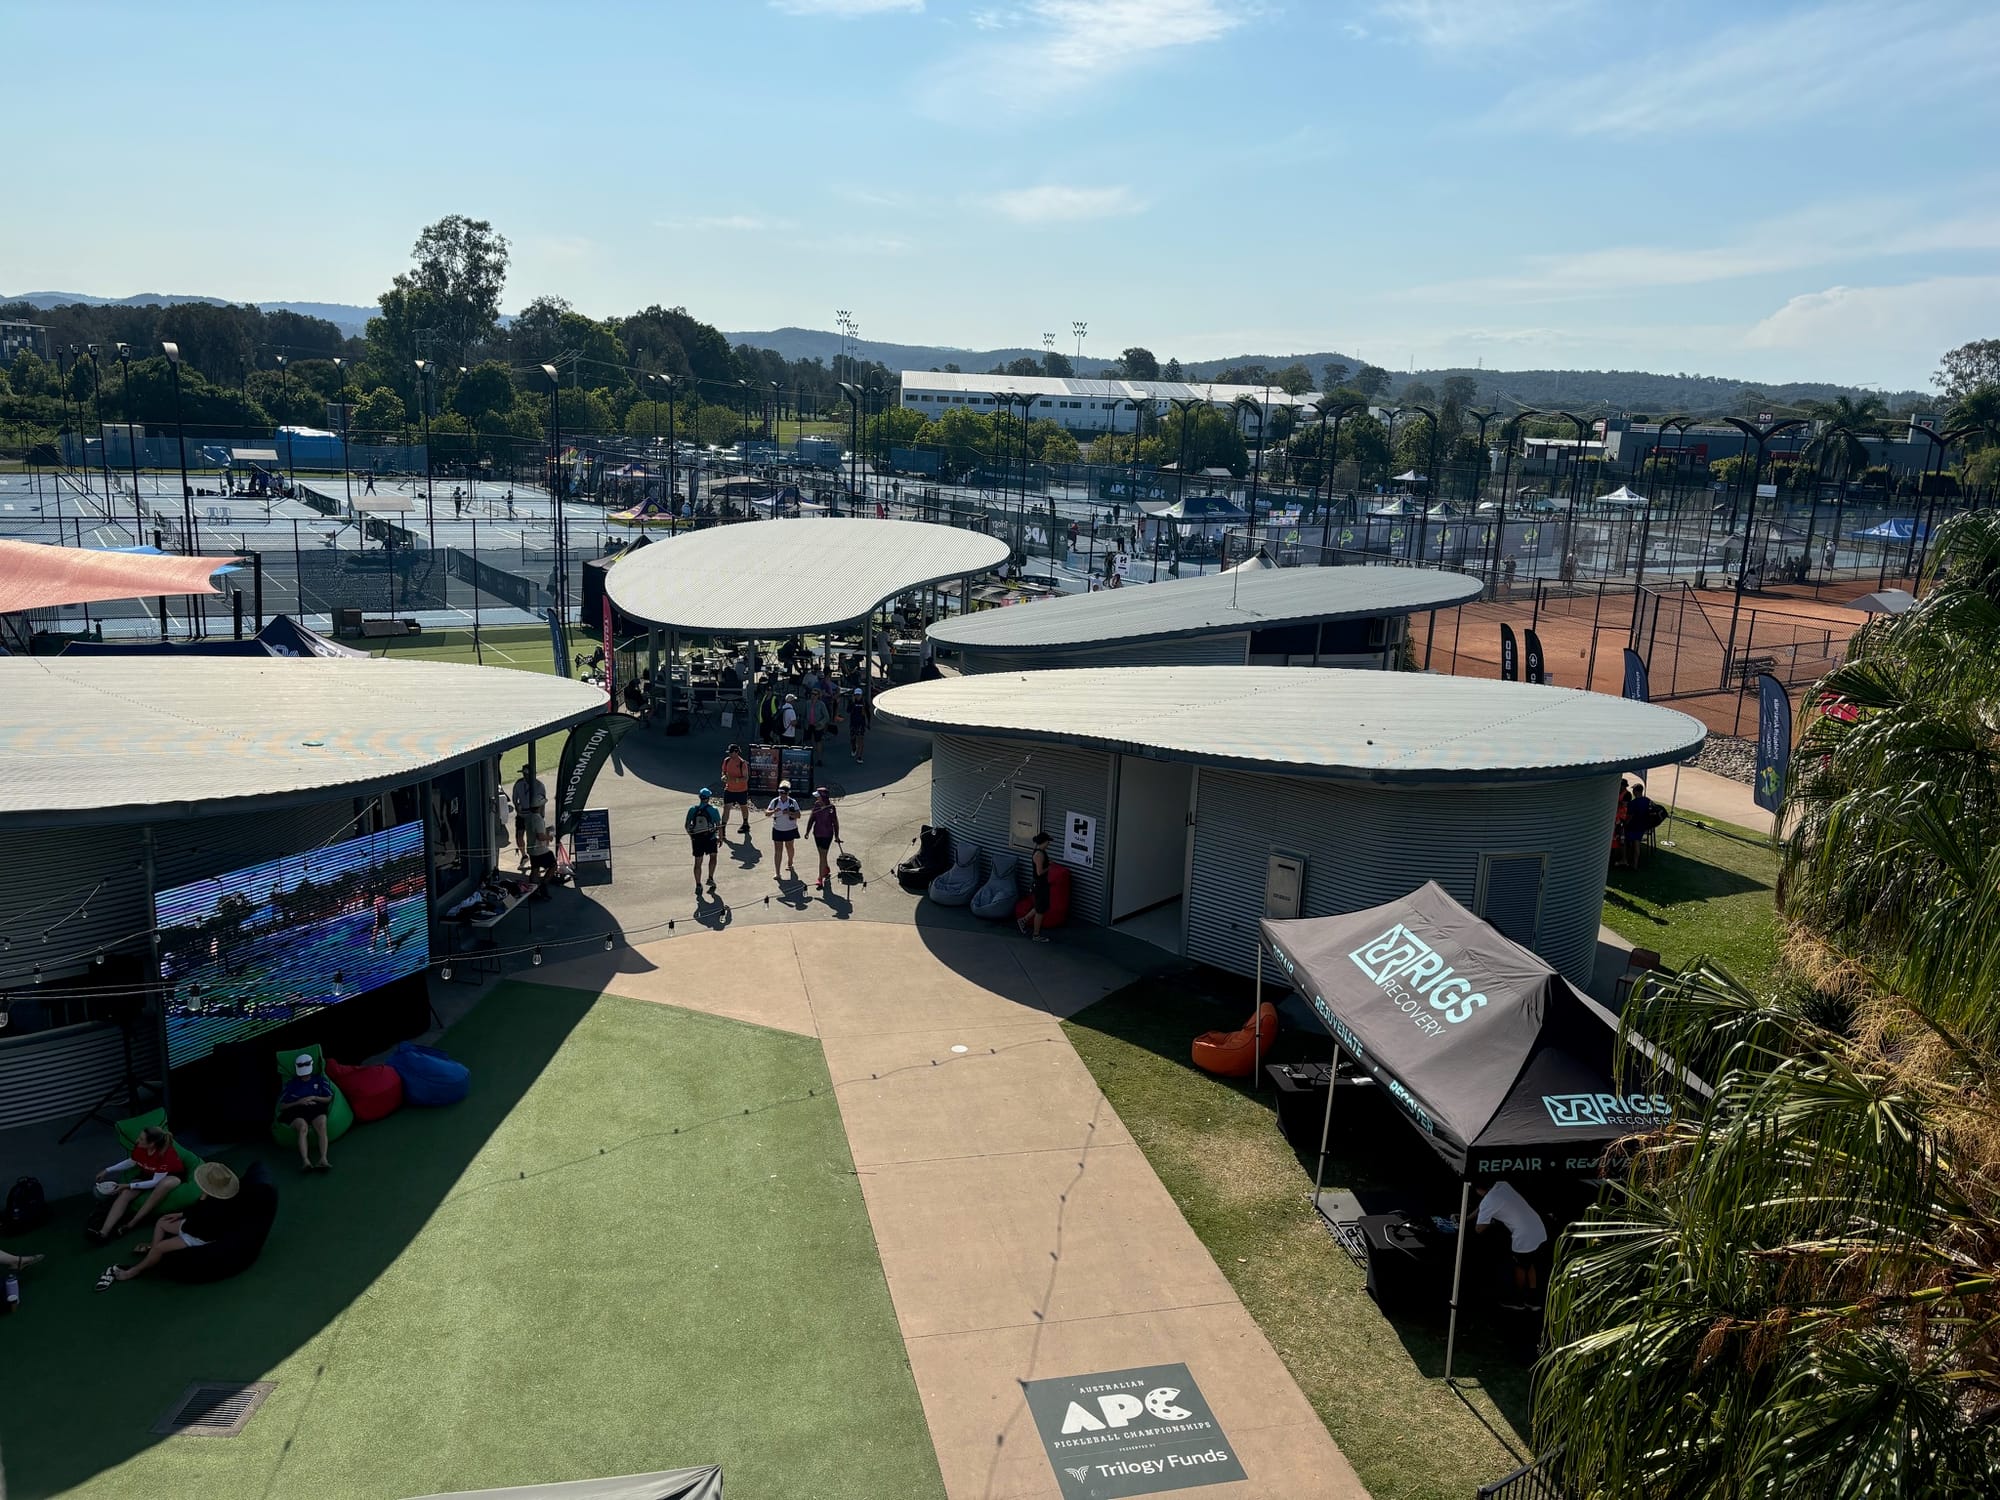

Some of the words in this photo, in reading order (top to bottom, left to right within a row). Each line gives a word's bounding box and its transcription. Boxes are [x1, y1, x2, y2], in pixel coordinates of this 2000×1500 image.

[564, 728, 609, 805] INFORMATION
[1401, 951, 1488, 1024] RIGS
[1380, 979, 1447, 1038] RECOVERY
[1314, 995, 1363, 1058] REJUVENATE
[1597, 1093, 1673, 1115] RIGS
[1607, 1116, 1673, 1126] RECOVER
[1478, 1157, 1542, 1173] REPAIR
[1079, 1379, 1146, 1395] AUSTRALIAN
[1061, 1387, 1193, 1435] APC
[1053, 1433, 1121, 1449] PICKLEBALL
[1123, 1421, 1212, 1441] CHAMPIONSHIPS
[1096, 1457, 1164, 1478] Trilogy
[1167, 1448, 1229, 1470] Funds
